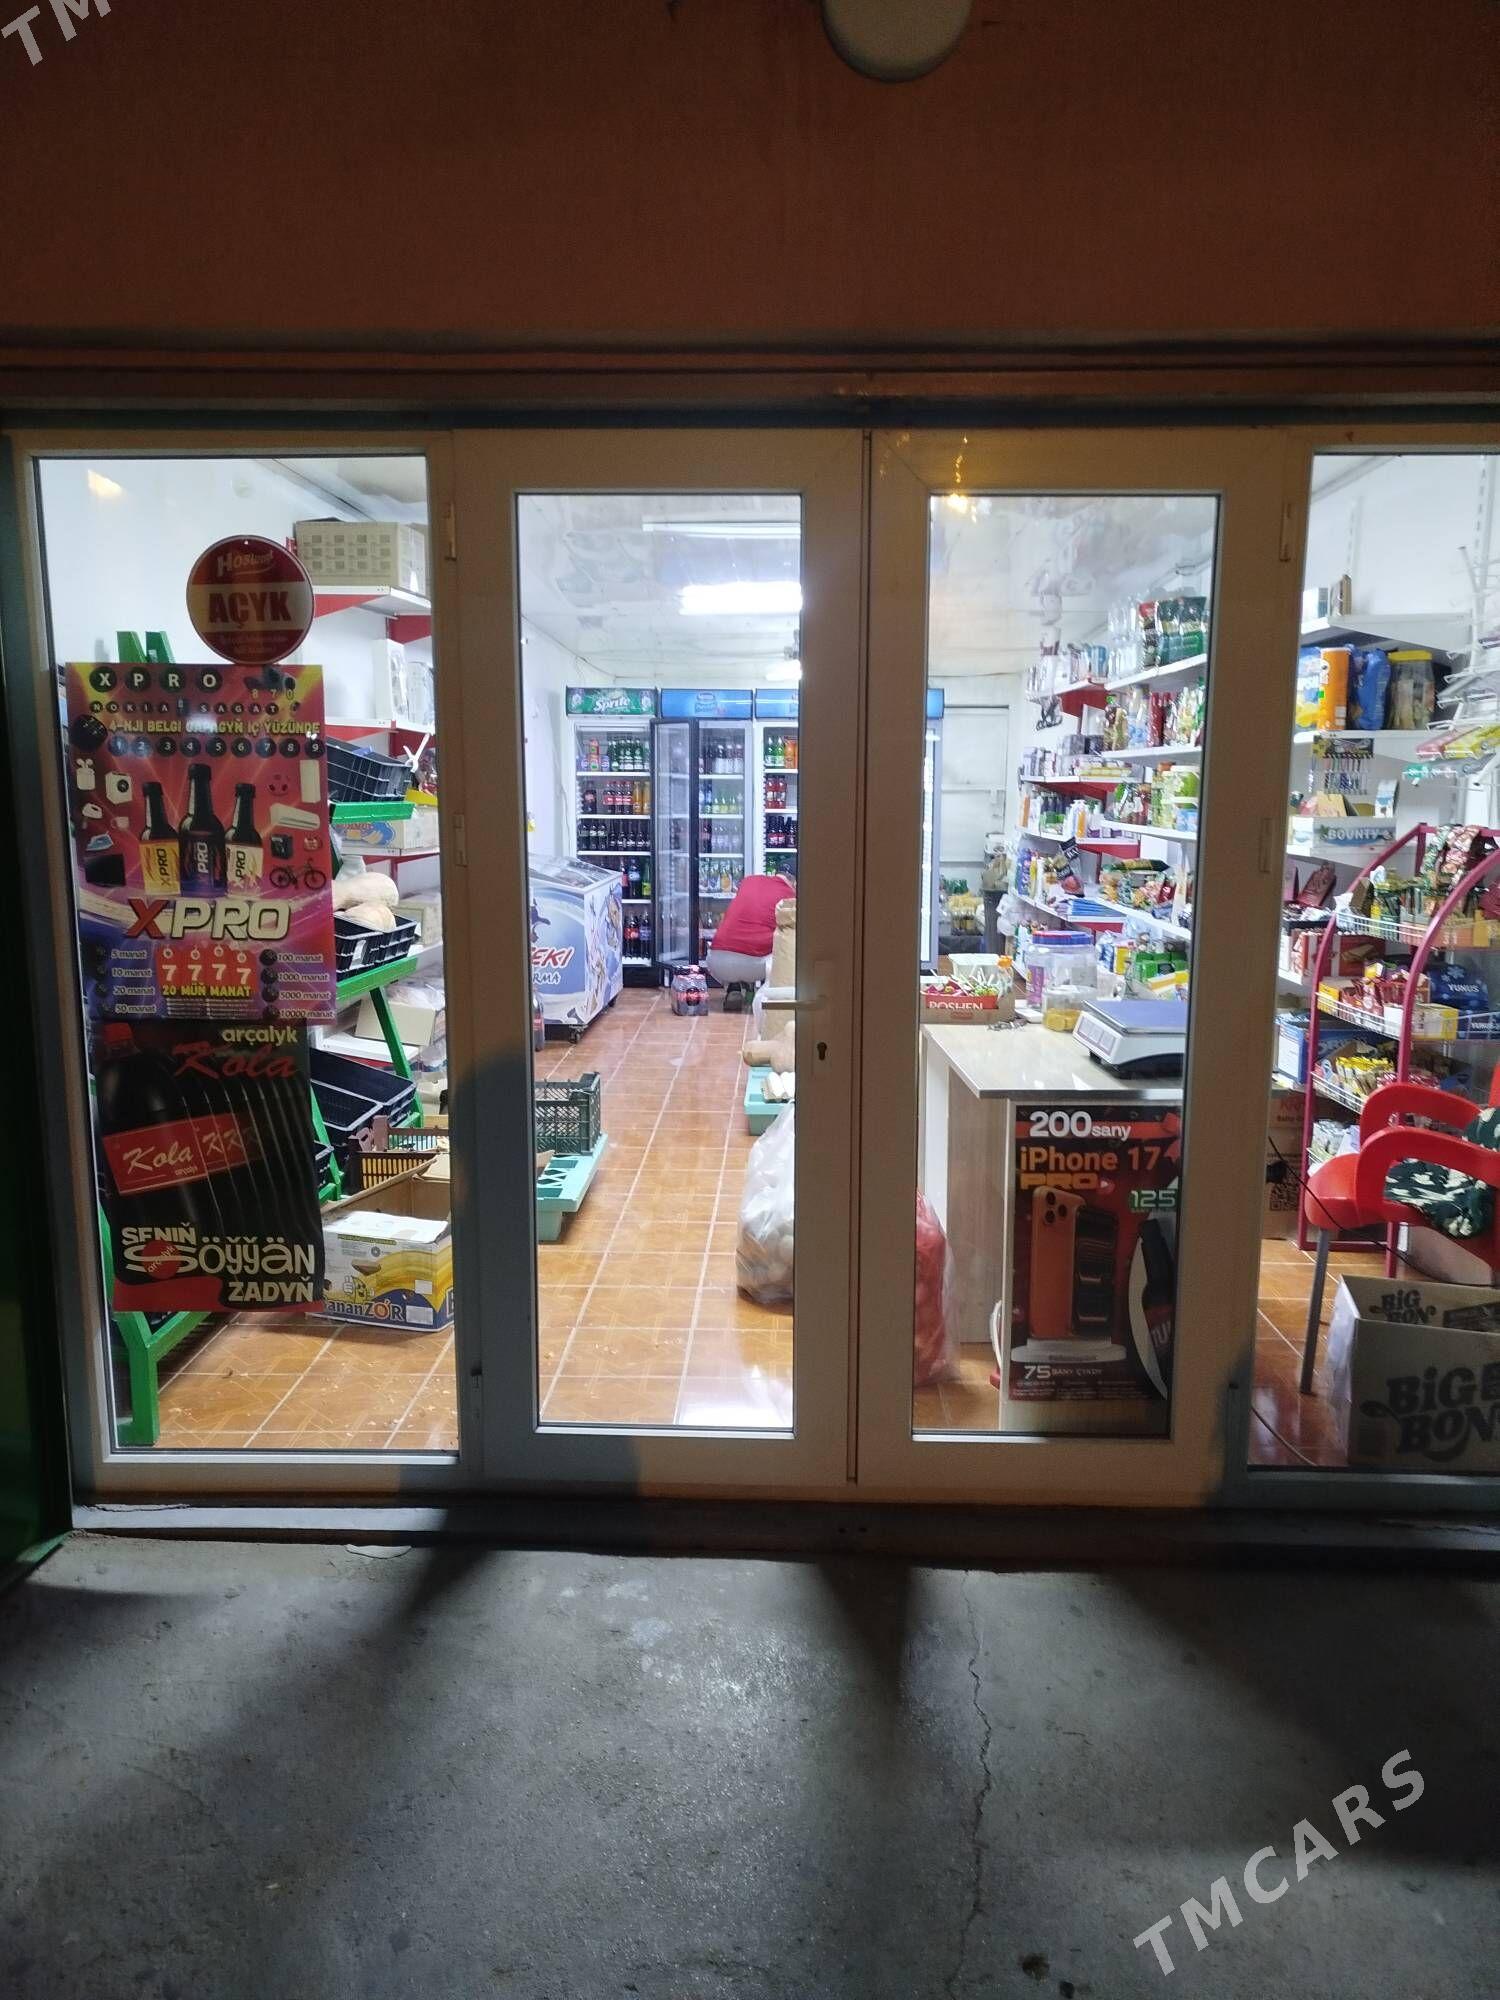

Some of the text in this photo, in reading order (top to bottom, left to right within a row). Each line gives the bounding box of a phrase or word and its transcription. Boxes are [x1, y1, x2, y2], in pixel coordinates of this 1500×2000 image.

[208, 591, 292, 629] AÇYK
[124, 900, 290, 940] XPRO
[531, 948, 574, 966] EKI
[533, 973, 560, 985] RMA
[162, 985, 176, 996] 20
[222, 1025, 298, 1046] arçalyk
[1029, 1111, 1092, 1138] 200
[123, 1142, 193, 1174] Kola
[1020, 1146, 1161, 1171] iPhone 17
[1020, 1173, 1099, 1190] PRO
[1130, 1190, 1176, 1208] 125
[228, 1276, 315, 1303] ZADYŇ
[1024, 1365, 1051, 1379] 75
